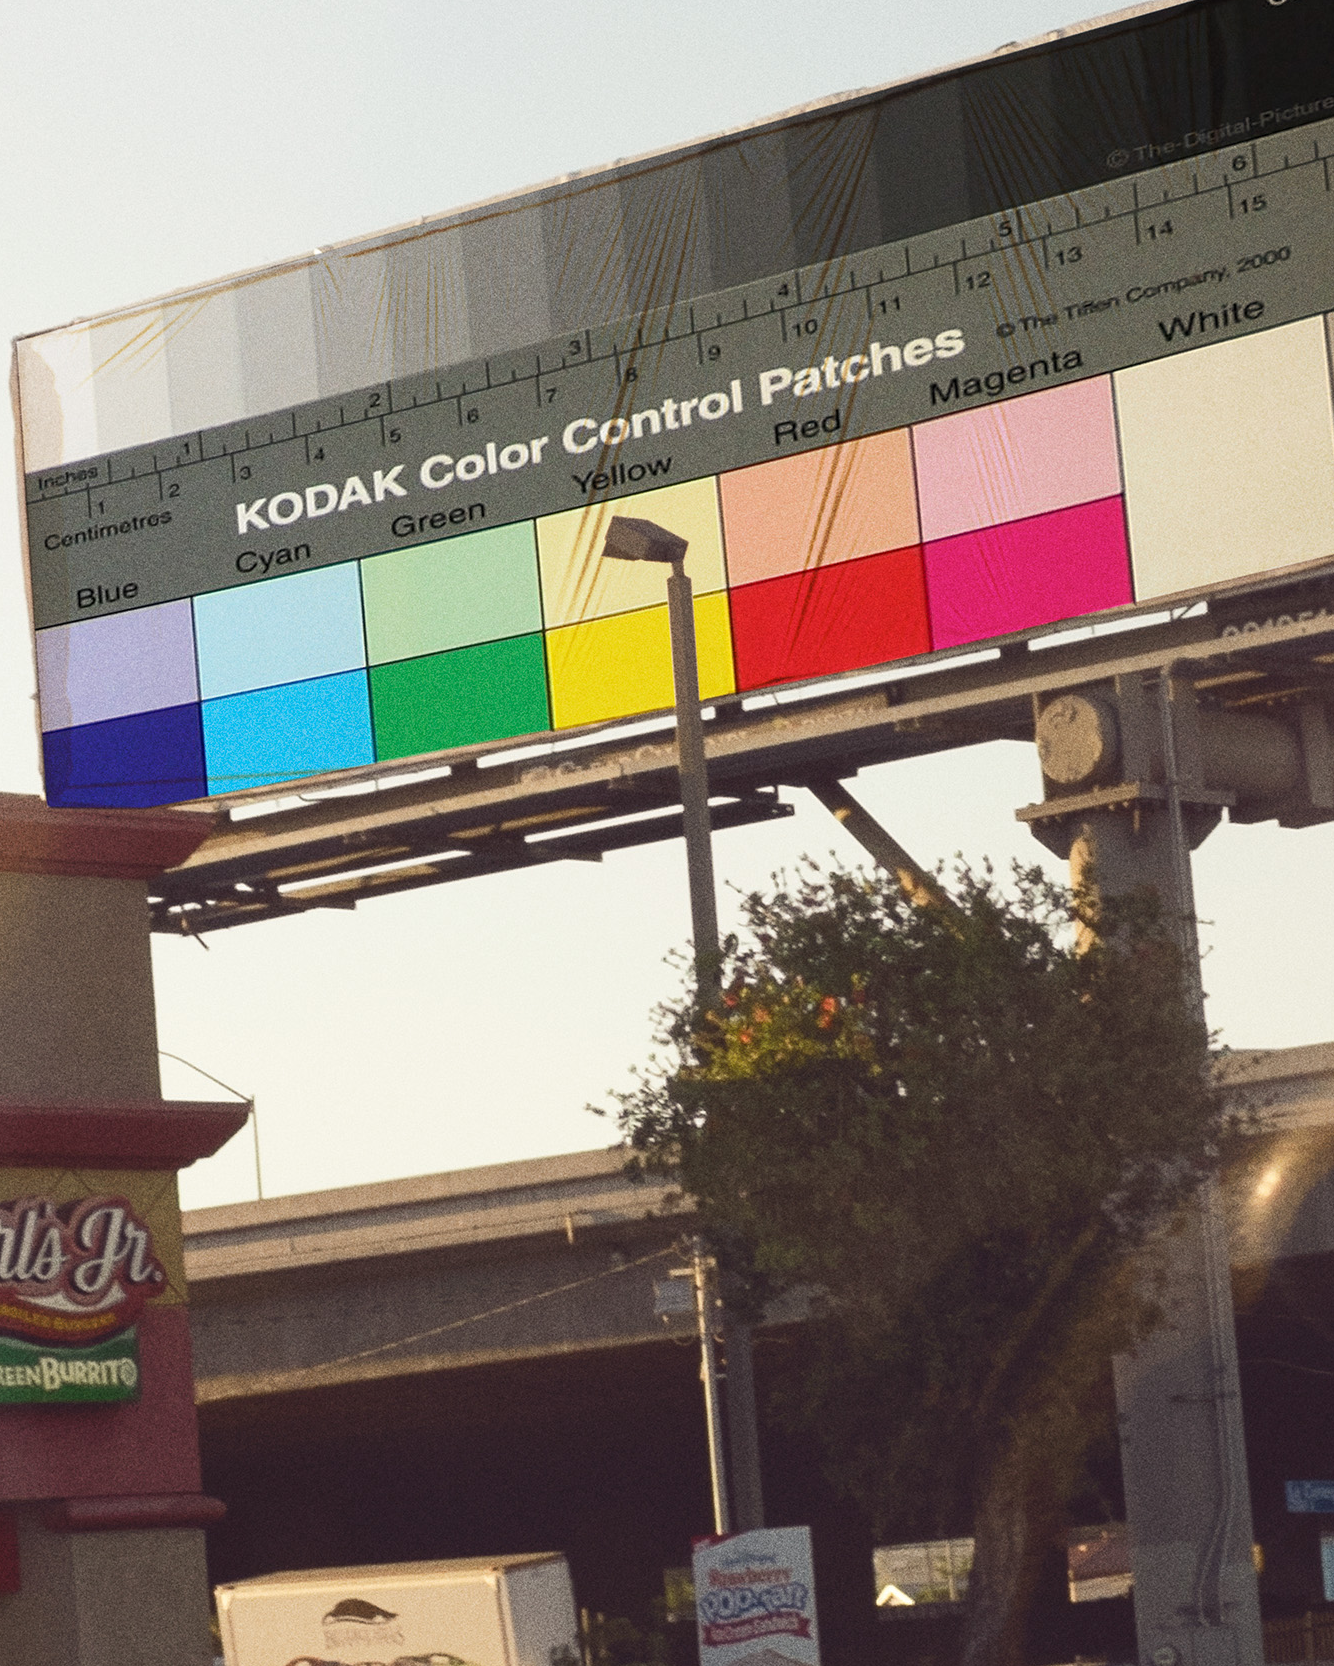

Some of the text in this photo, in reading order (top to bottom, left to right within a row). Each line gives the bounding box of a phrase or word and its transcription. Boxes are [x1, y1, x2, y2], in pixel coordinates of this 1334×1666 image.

[38, 466, 99, 491] Inches
[368, 392, 382, 409] 2
[569, 339, 582, 355] 3
[776, 282, 790, 298] 4
[997, 219, 1013, 238] 5
[1231, 154, 1247, 172] 6
[168, 483, 181, 498] 2
[239, 466, 252, 483] 3
[313, 447, 326, 463] 4
[389, 426, 402, 444] 5
[467, 406, 480, 424] 6
[546, 386, 559, 404] 7
[626, 366, 639, 384] 8
[707, 343, 721, 361] 9
[792, 316, 820, 338] 10
[878, 296, 901, 317] 11
[964, 269, 992, 292] 12
[1055, 246, 1084, 266] 13
[1146, 218, 1175, 239] 14
[1238, 193, 1268, 214] 15
[1019, 313, 1059, 332] The
[1063, 295, 1121, 322] Tiffen
[1126, 267, 1230, 304] Company,
[1237, 245, 1292, 274] 2000
[44, 511, 172, 551] Centimetres
[76, 577, 139, 610] Blue
[234, 538, 312, 576] Cyan
[390, 501, 487, 540] Green
[572, 455, 673, 496] Yellow
[772, 409, 843, 447] Red
[928, 345, 1085, 408] Magenta
[1157, 296, 1266, 344] White
[236, 325, 967, 535] KODAK Color Control Patches
[73, 1205, 164, 1294] Jr.
